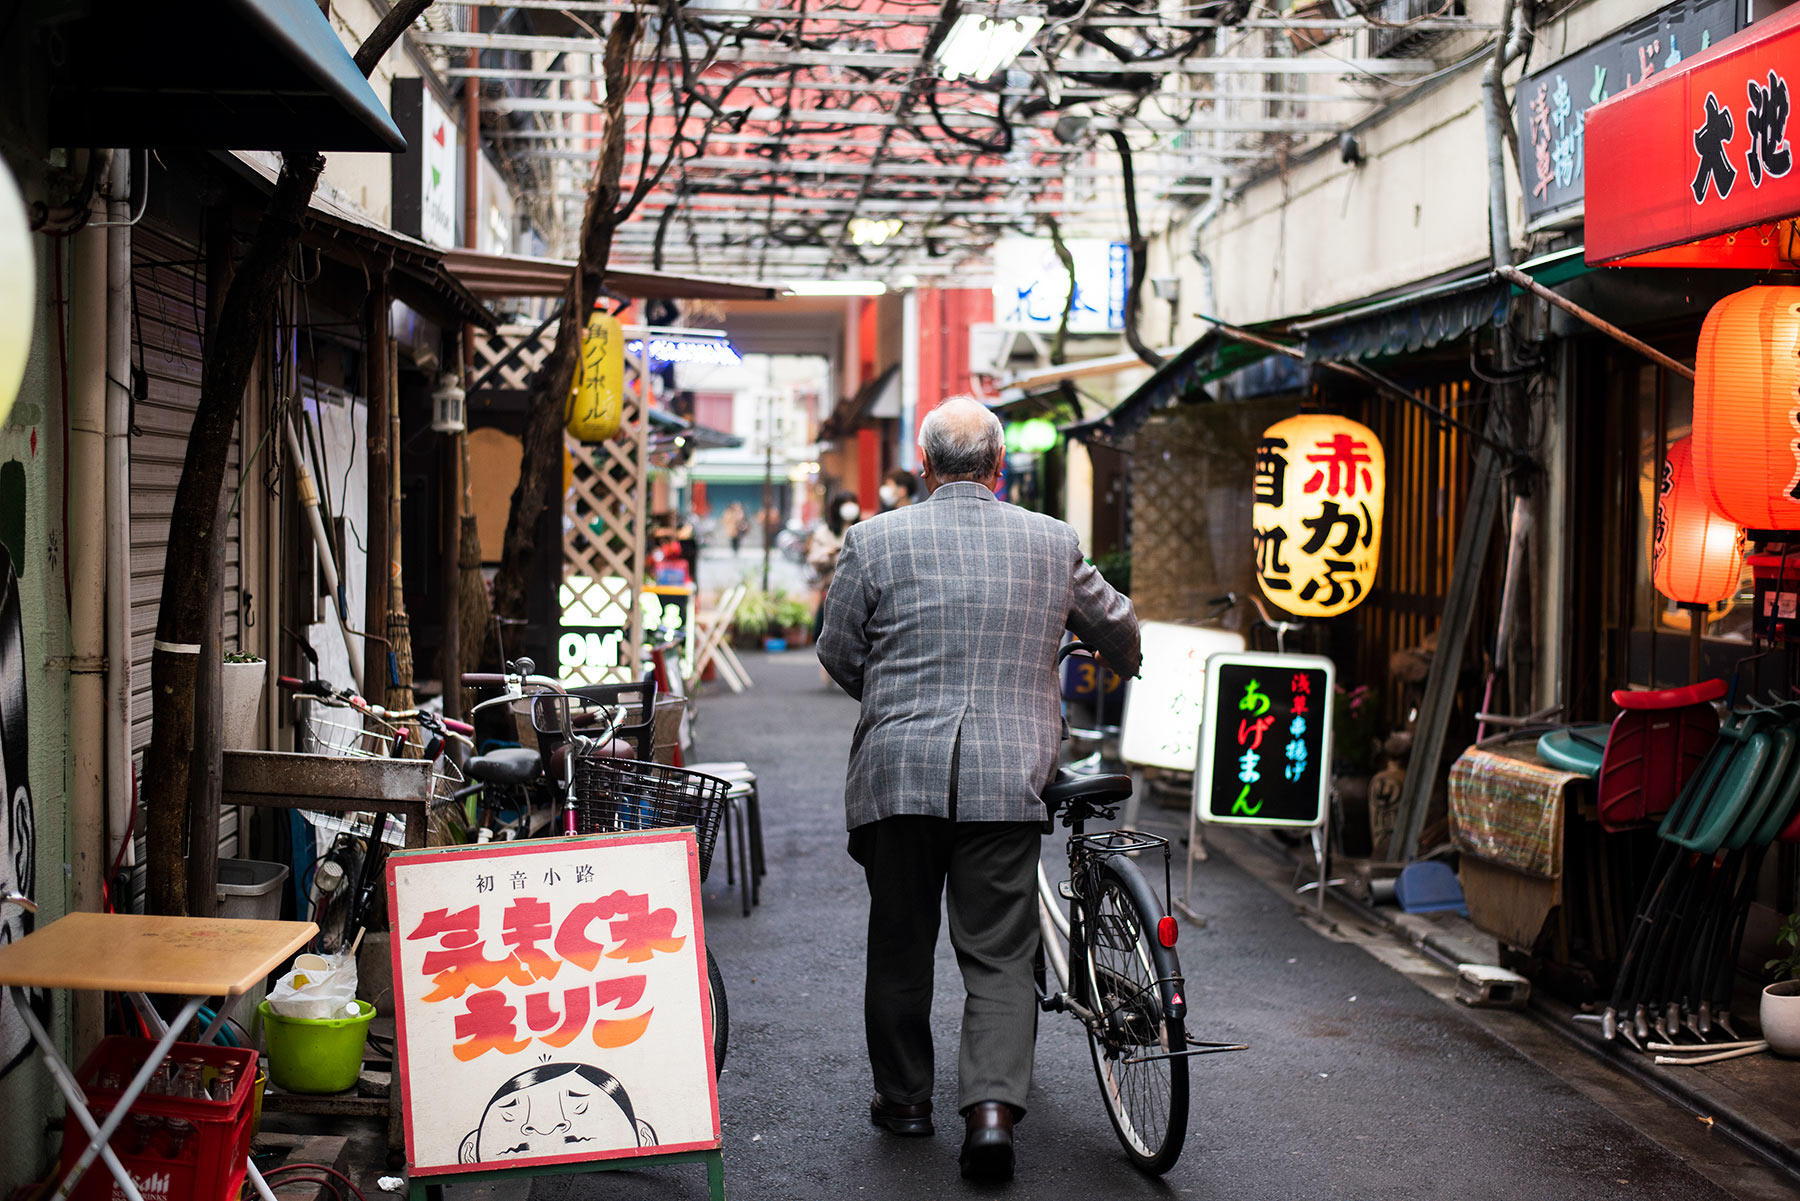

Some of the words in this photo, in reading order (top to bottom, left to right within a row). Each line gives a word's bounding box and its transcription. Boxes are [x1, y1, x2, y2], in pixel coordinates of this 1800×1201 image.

[1299, 434, 1373, 607] 赤かぶ
[1231, 679, 1275, 815] あげまん
[475, 863, 595, 894] 初音小路
[452, 974, 654, 1063] えりこ
